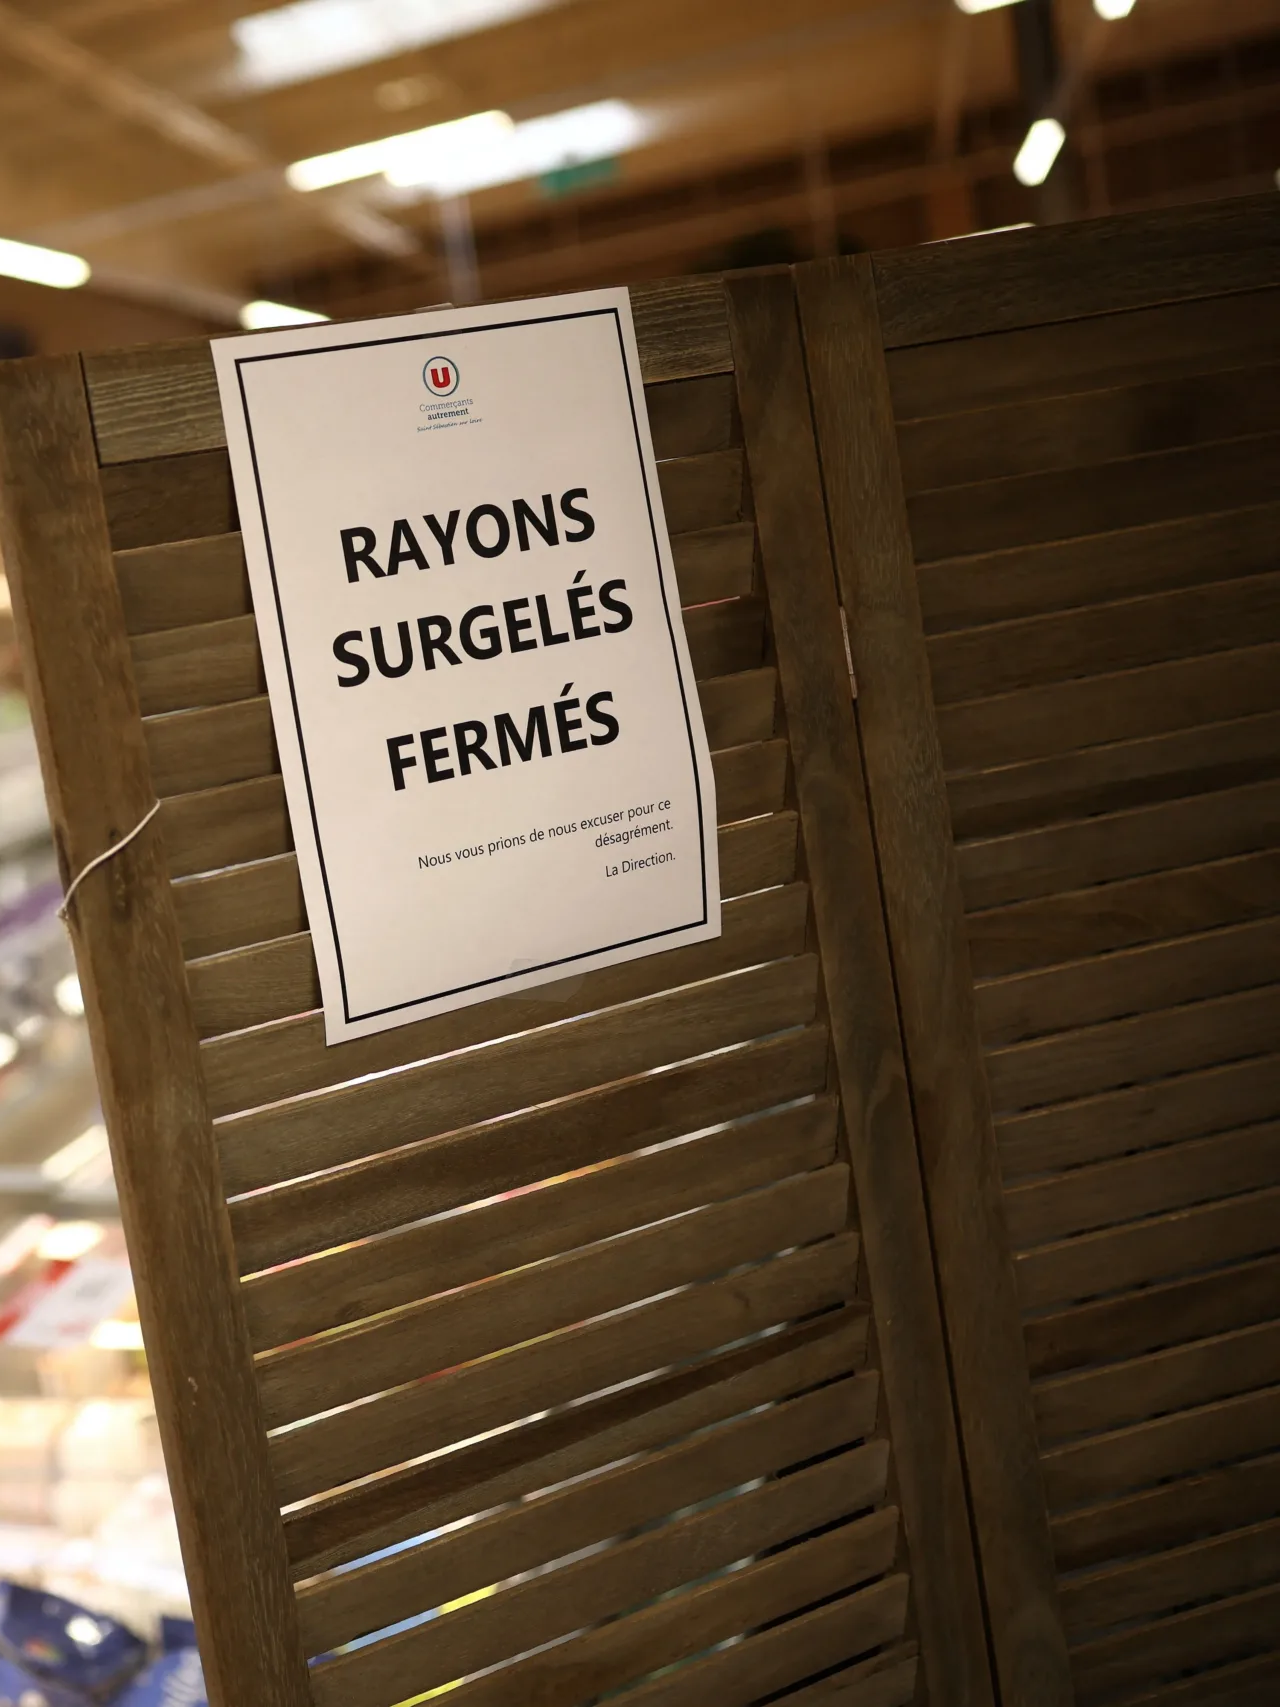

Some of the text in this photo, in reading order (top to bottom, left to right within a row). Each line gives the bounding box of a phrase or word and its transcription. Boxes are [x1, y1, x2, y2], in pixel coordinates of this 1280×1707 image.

[419, 398, 474, 412] Commerçants
[427, 408, 469, 420] autrement
[339, 487, 596, 583] RAYONS
[332, 569, 634, 688] SURGELÉS
[386, 682, 620, 792] FERMÉS
[418, 799, 671, 869] Nous vous prions de nous excuser pour ce
[595, 818, 674, 848] désagrément.
[605, 851, 676, 877] La Direction.
